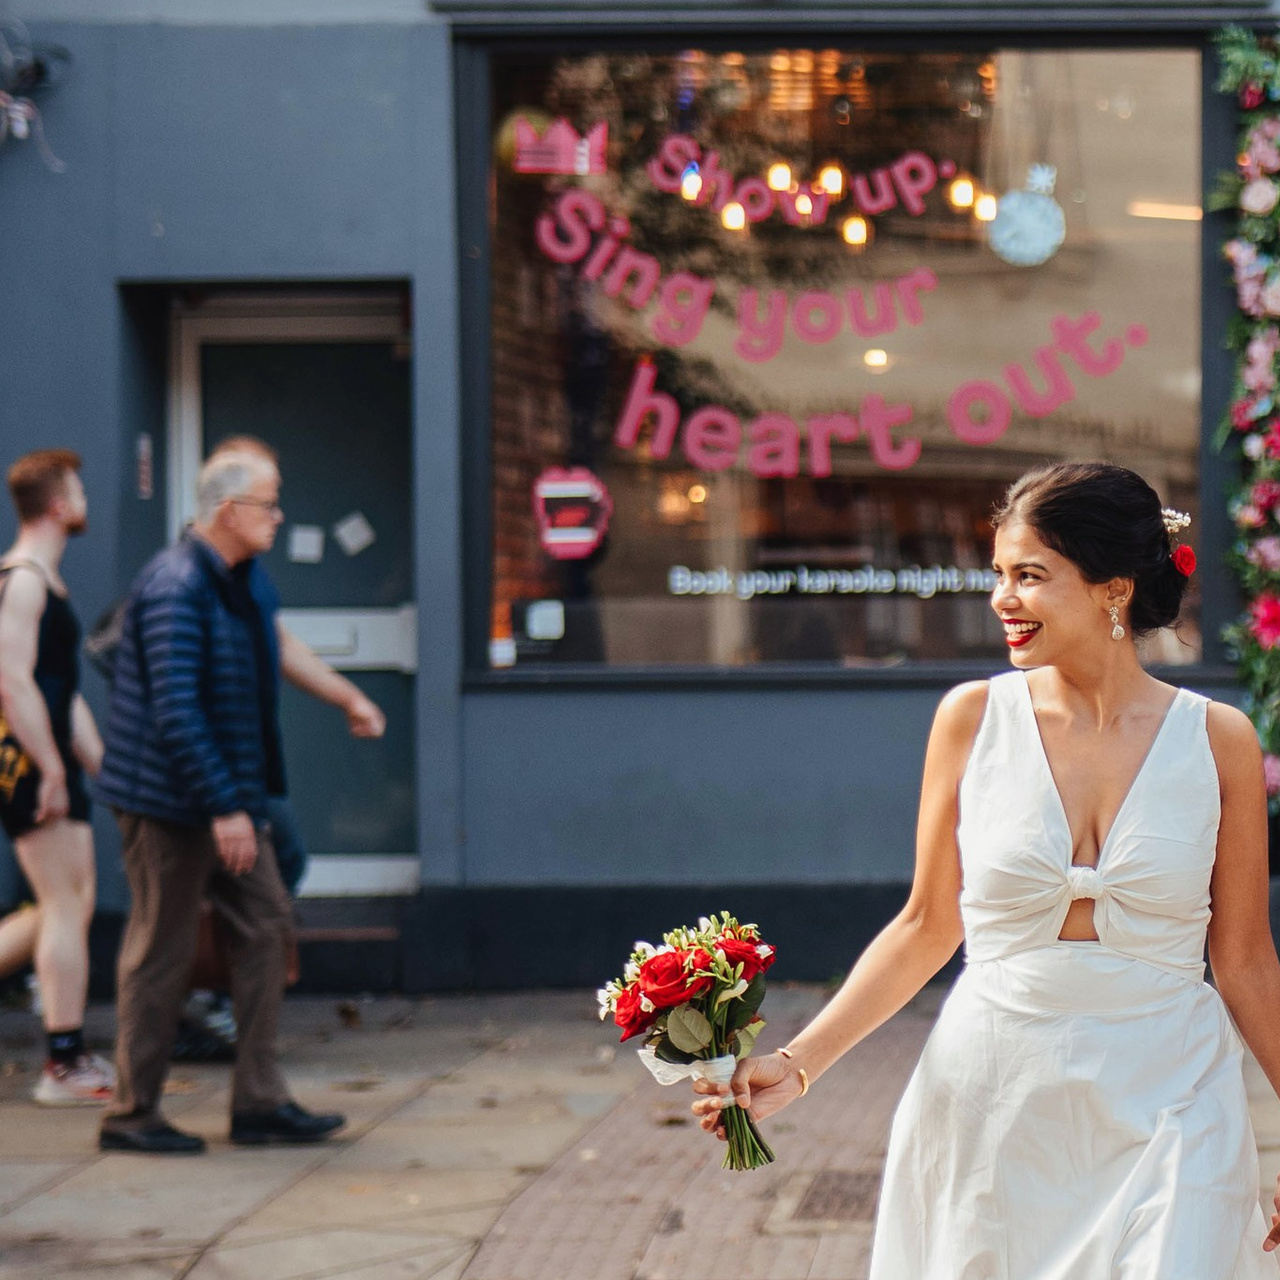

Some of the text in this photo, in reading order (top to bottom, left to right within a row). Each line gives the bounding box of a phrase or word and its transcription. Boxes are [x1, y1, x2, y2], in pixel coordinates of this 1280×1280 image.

[647, 133, 830, 226] Show
[537, 187, 939, 363] Sing your
[615, 312, 1150, 479] heart out.
[668, 564, 733, 595] Book
[735, 569, 796, 600] your
[797, 564, 896, 594] karaoke
